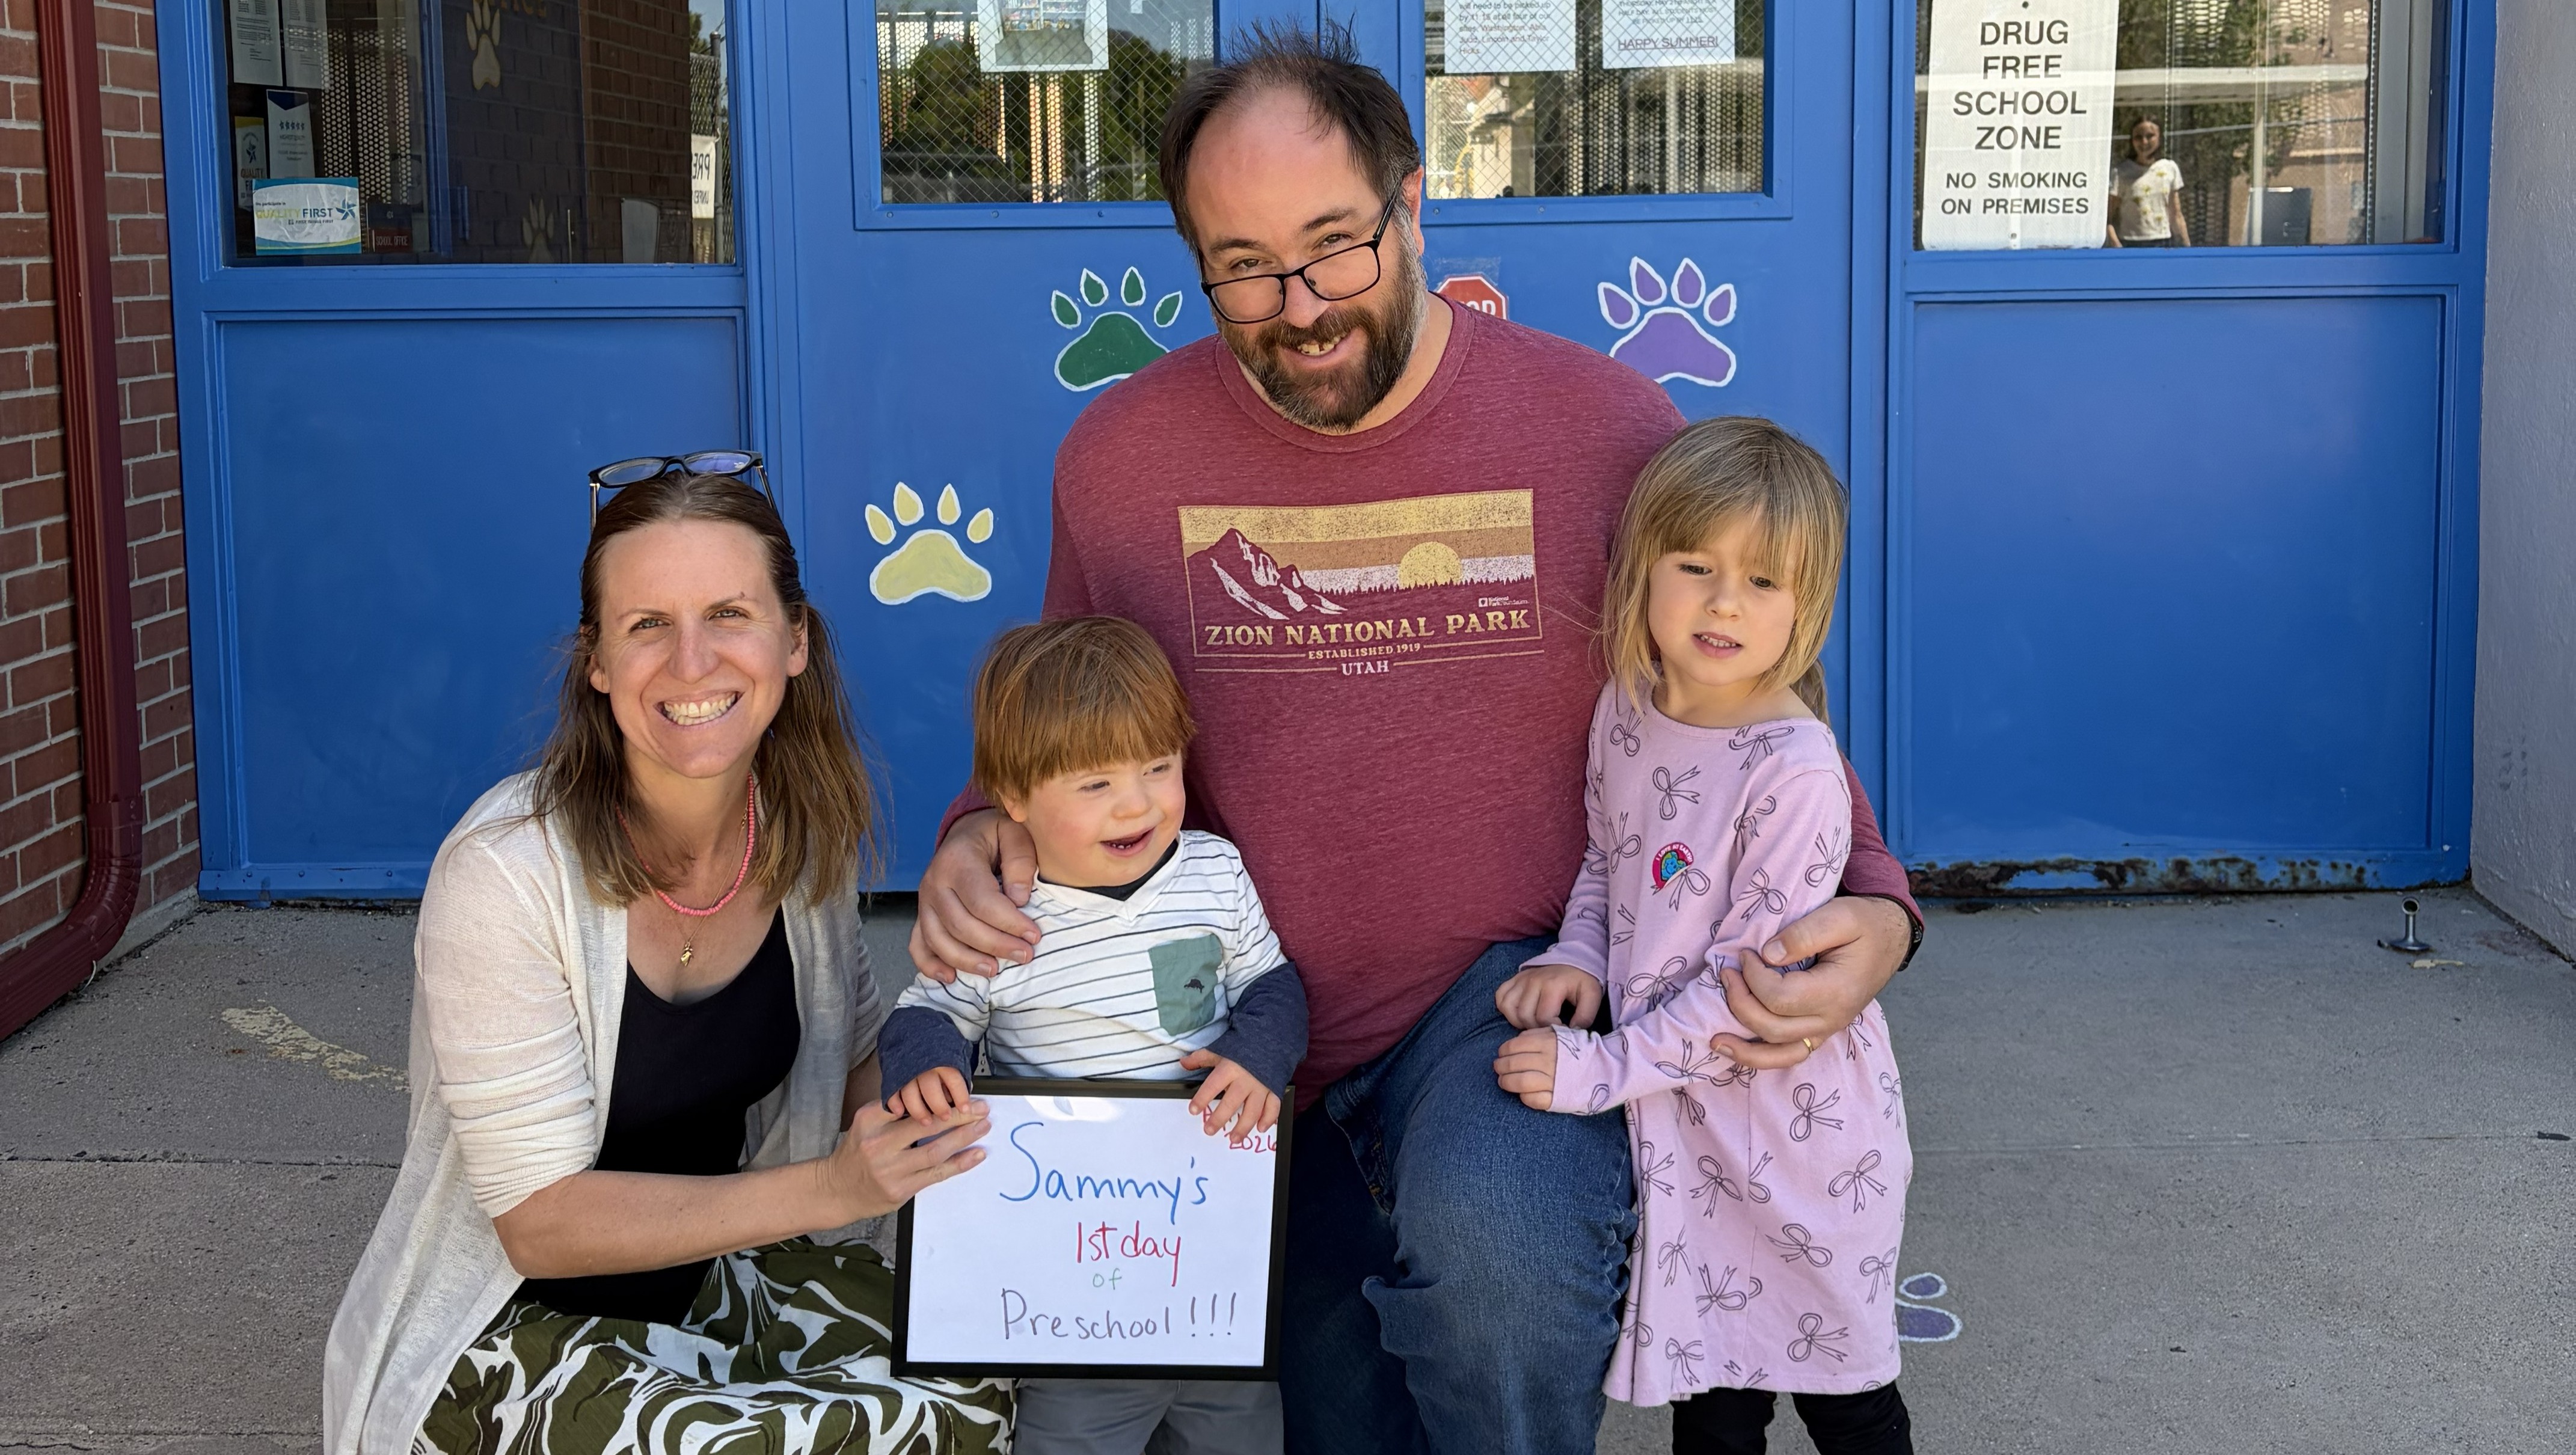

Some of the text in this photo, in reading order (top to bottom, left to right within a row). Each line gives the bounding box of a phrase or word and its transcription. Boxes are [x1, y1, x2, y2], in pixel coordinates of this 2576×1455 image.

[1618, 36, 1718, 50] HAPPY SUMMER!
[1980, 20, 2068, 45] DRUG
[1983, 55, 2062, 79] FREE
[1953, 91, 2087, 115] SCHOOL
[1975, 126, 2061, 150] ZONE
[1946, 172, 2087, 188] NO SMOKING
[256, 208, 334, 219] QUALITY FIRST
[1941, 198, 2088, 214] ON PREMISES
[393, 236, 408, 246] OFFICE
[1204, 609, 1530, 646] ZION NATIONAL PARK
[1308, 643, 1420, 660] ESTABLISHED 1919
[1342, 660, 1389, 676] UTAH
[1001, 1123, 1209, 1225] Sammy's
[1077, 1221, 1181, 1287] 1st day
[1093, 1268, 1122, 1290] of
